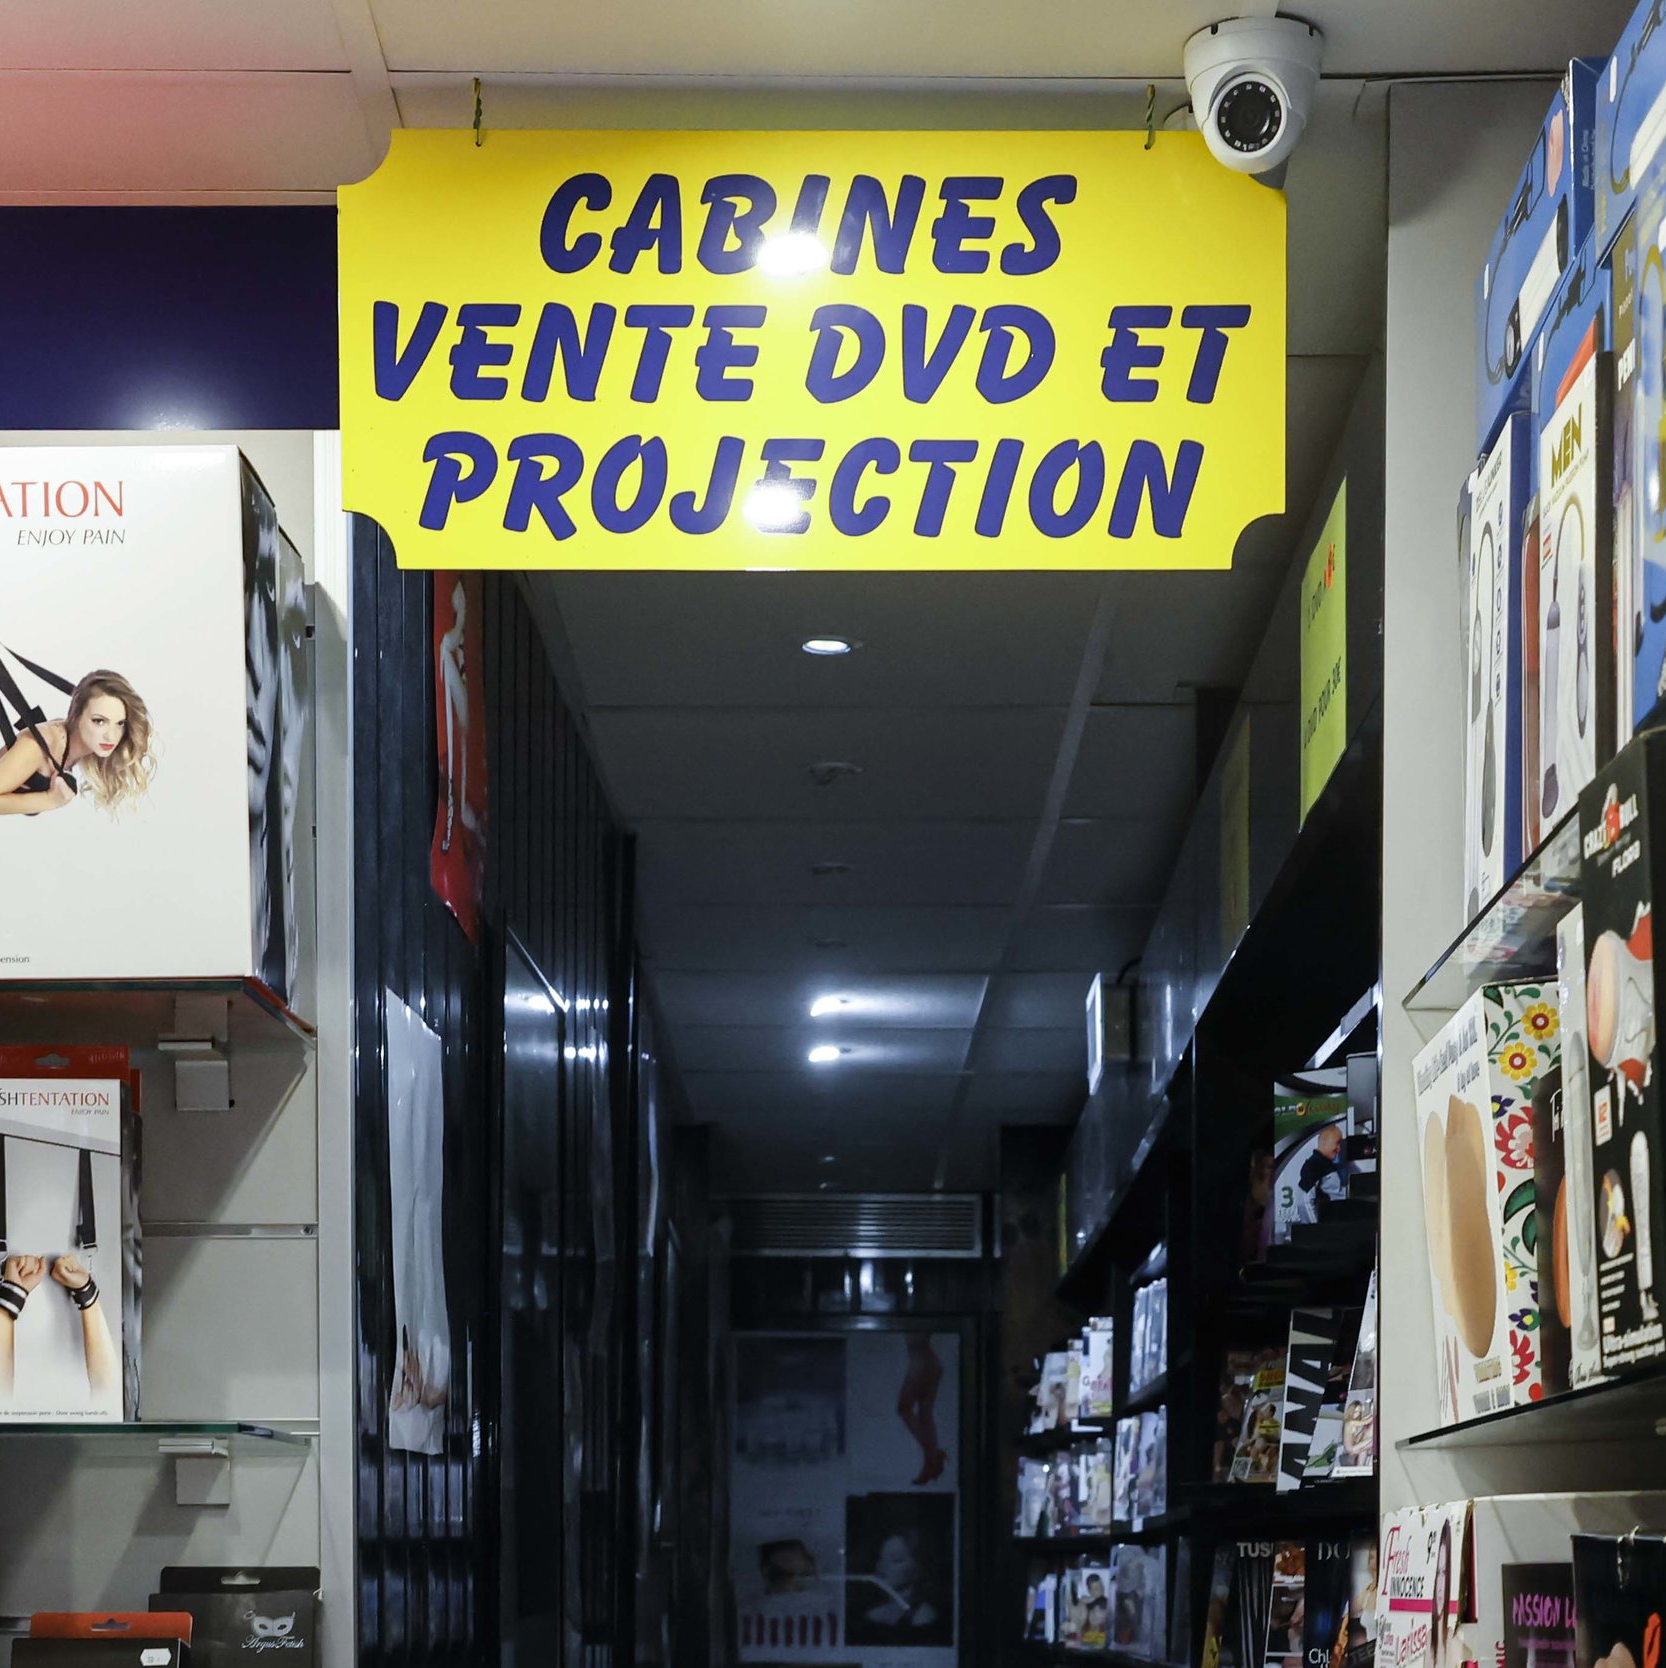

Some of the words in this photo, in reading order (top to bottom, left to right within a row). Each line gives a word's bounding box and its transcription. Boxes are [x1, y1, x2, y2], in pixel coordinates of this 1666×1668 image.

[539, 172, 1077, 276] CABINES
[371, 300, 767, 404] VENTE
[806, 302, 1056, 404] DVD
[1100, 304, 1251, 404] ET
[418, 429, 1204, 541] PROJECTION
[18, 529, 76, 549] ENJOY
[83, 529, 125, 547] PAIN
[1512, 1593, 1561, 1628] PASSION
